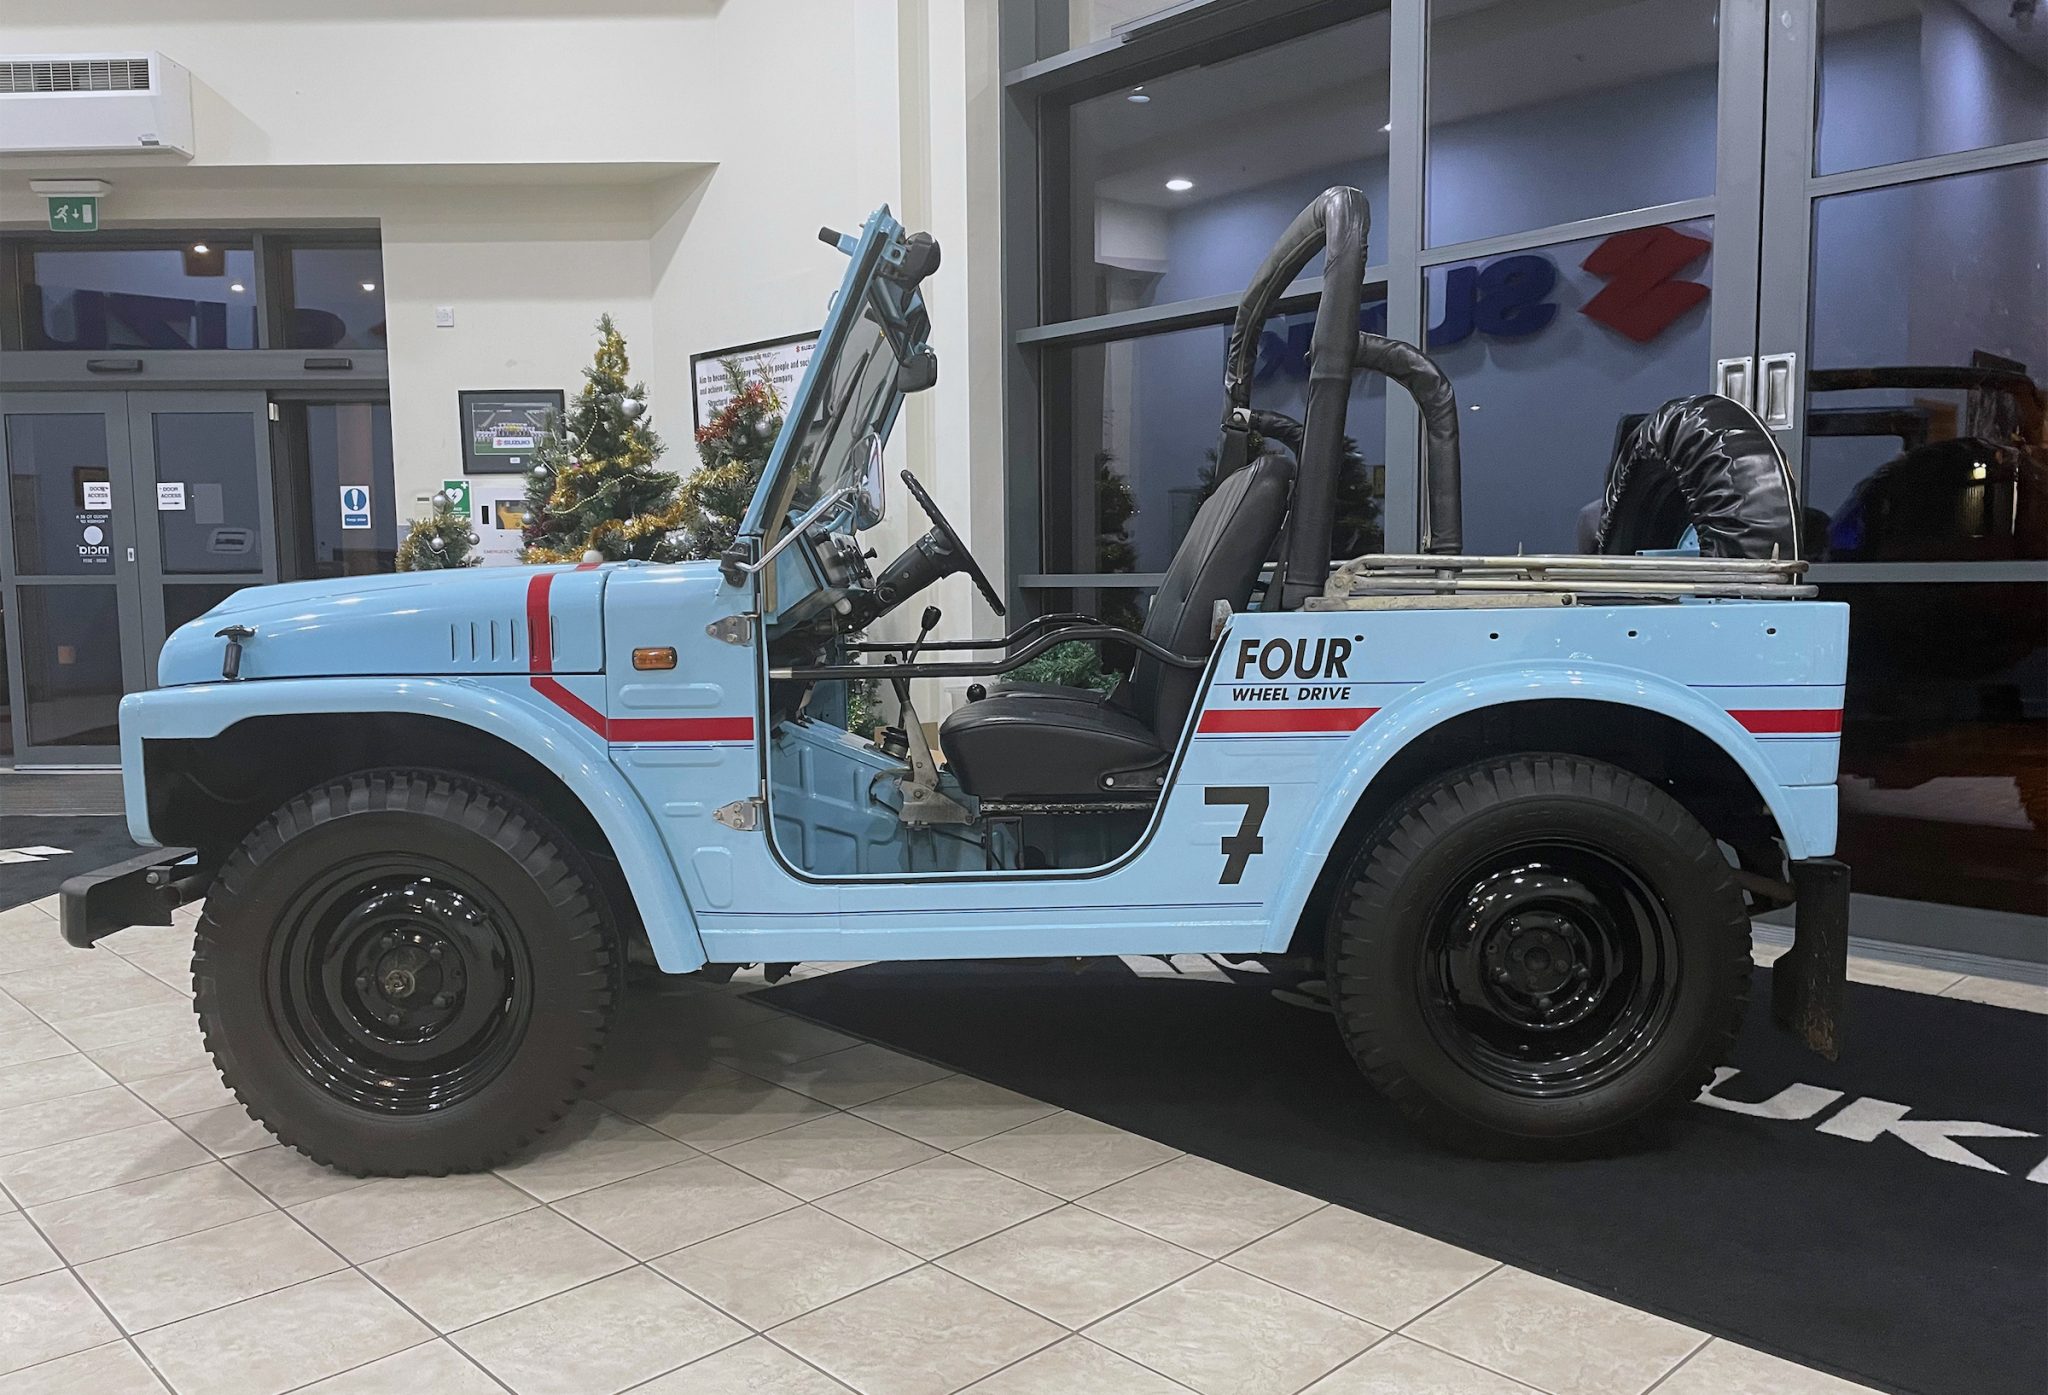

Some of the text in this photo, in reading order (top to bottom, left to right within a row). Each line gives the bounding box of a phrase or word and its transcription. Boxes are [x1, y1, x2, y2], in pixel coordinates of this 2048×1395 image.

[790, 359, 799, 369] and
[1235, 637, 1352, 680] FOUR
[1232, 686, 1352, 702] WHEEL DRIVE
[1204, 786, 1270, 885] 7
